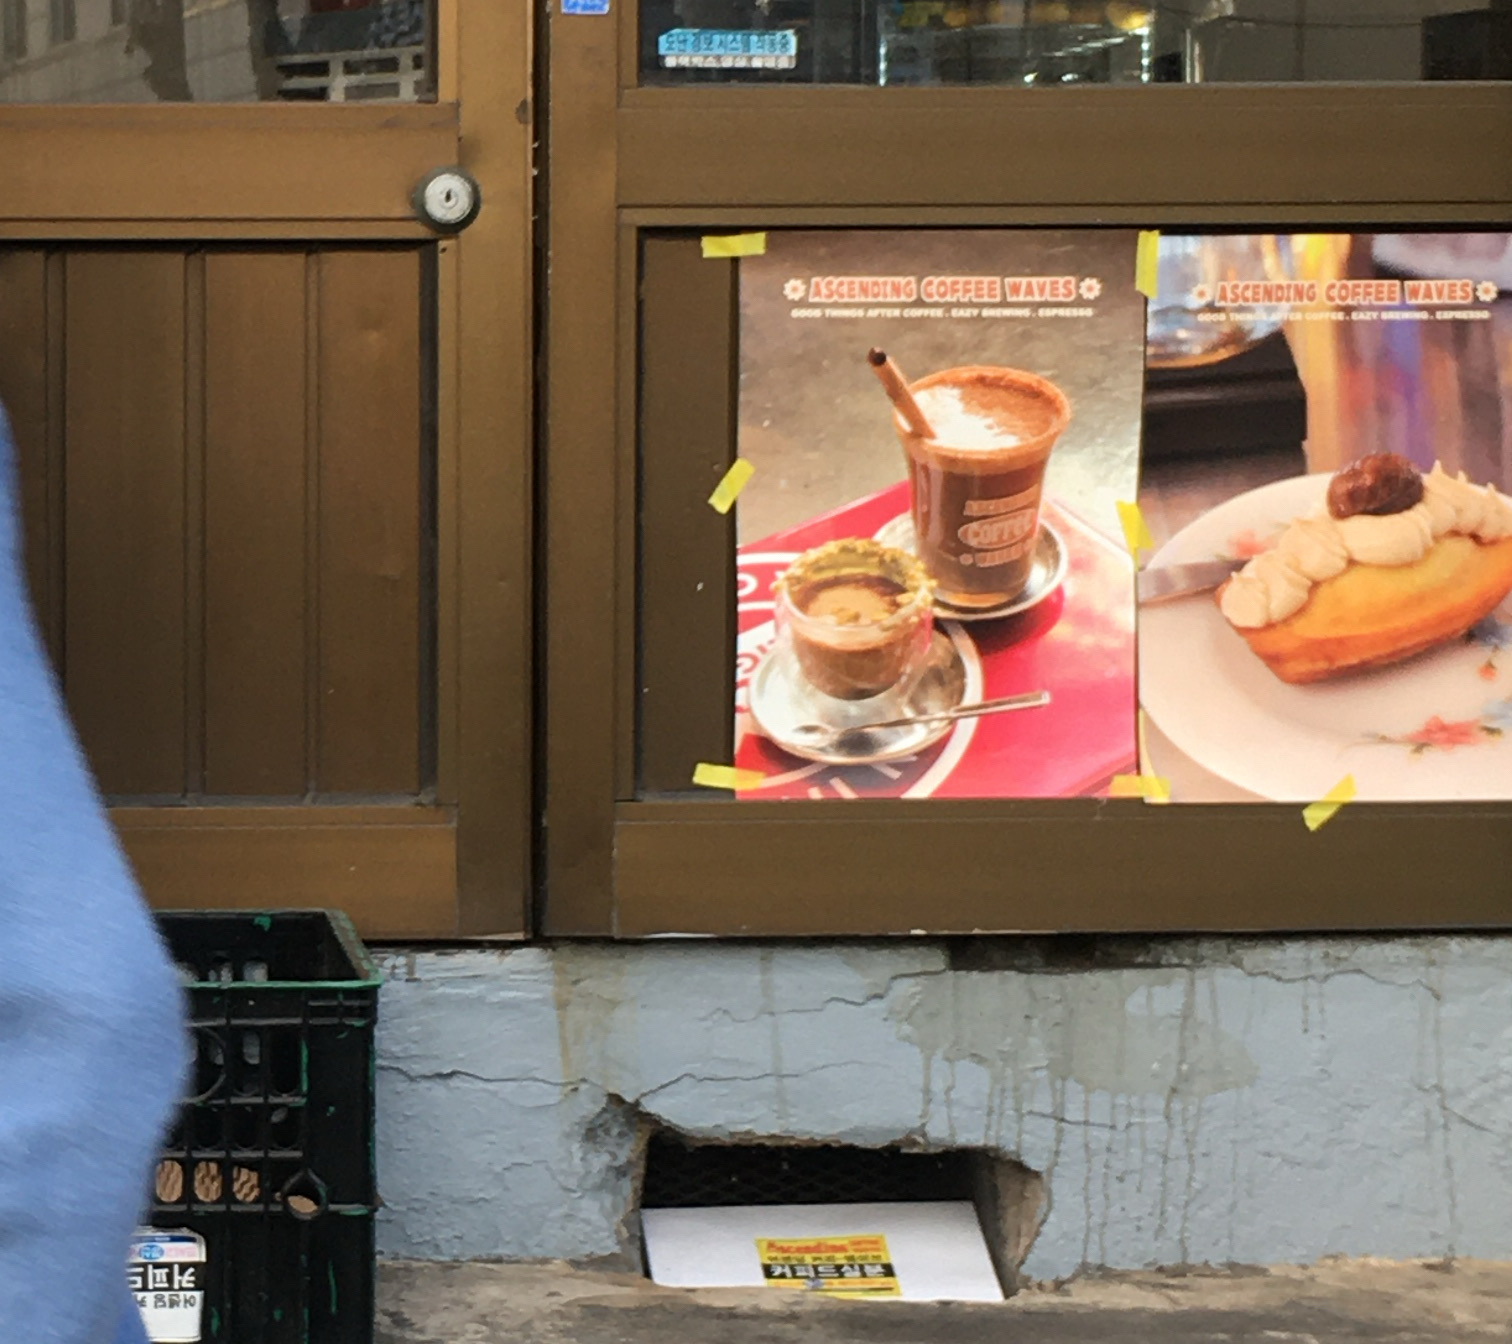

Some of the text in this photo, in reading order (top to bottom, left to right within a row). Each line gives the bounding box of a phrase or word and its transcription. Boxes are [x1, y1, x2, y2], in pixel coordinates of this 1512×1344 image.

[808, 276, 1078, 303] ASCENDING COFFEE WAVES
[1216, 279, 1474, 306] ASCENDING COFFEE WAVES
